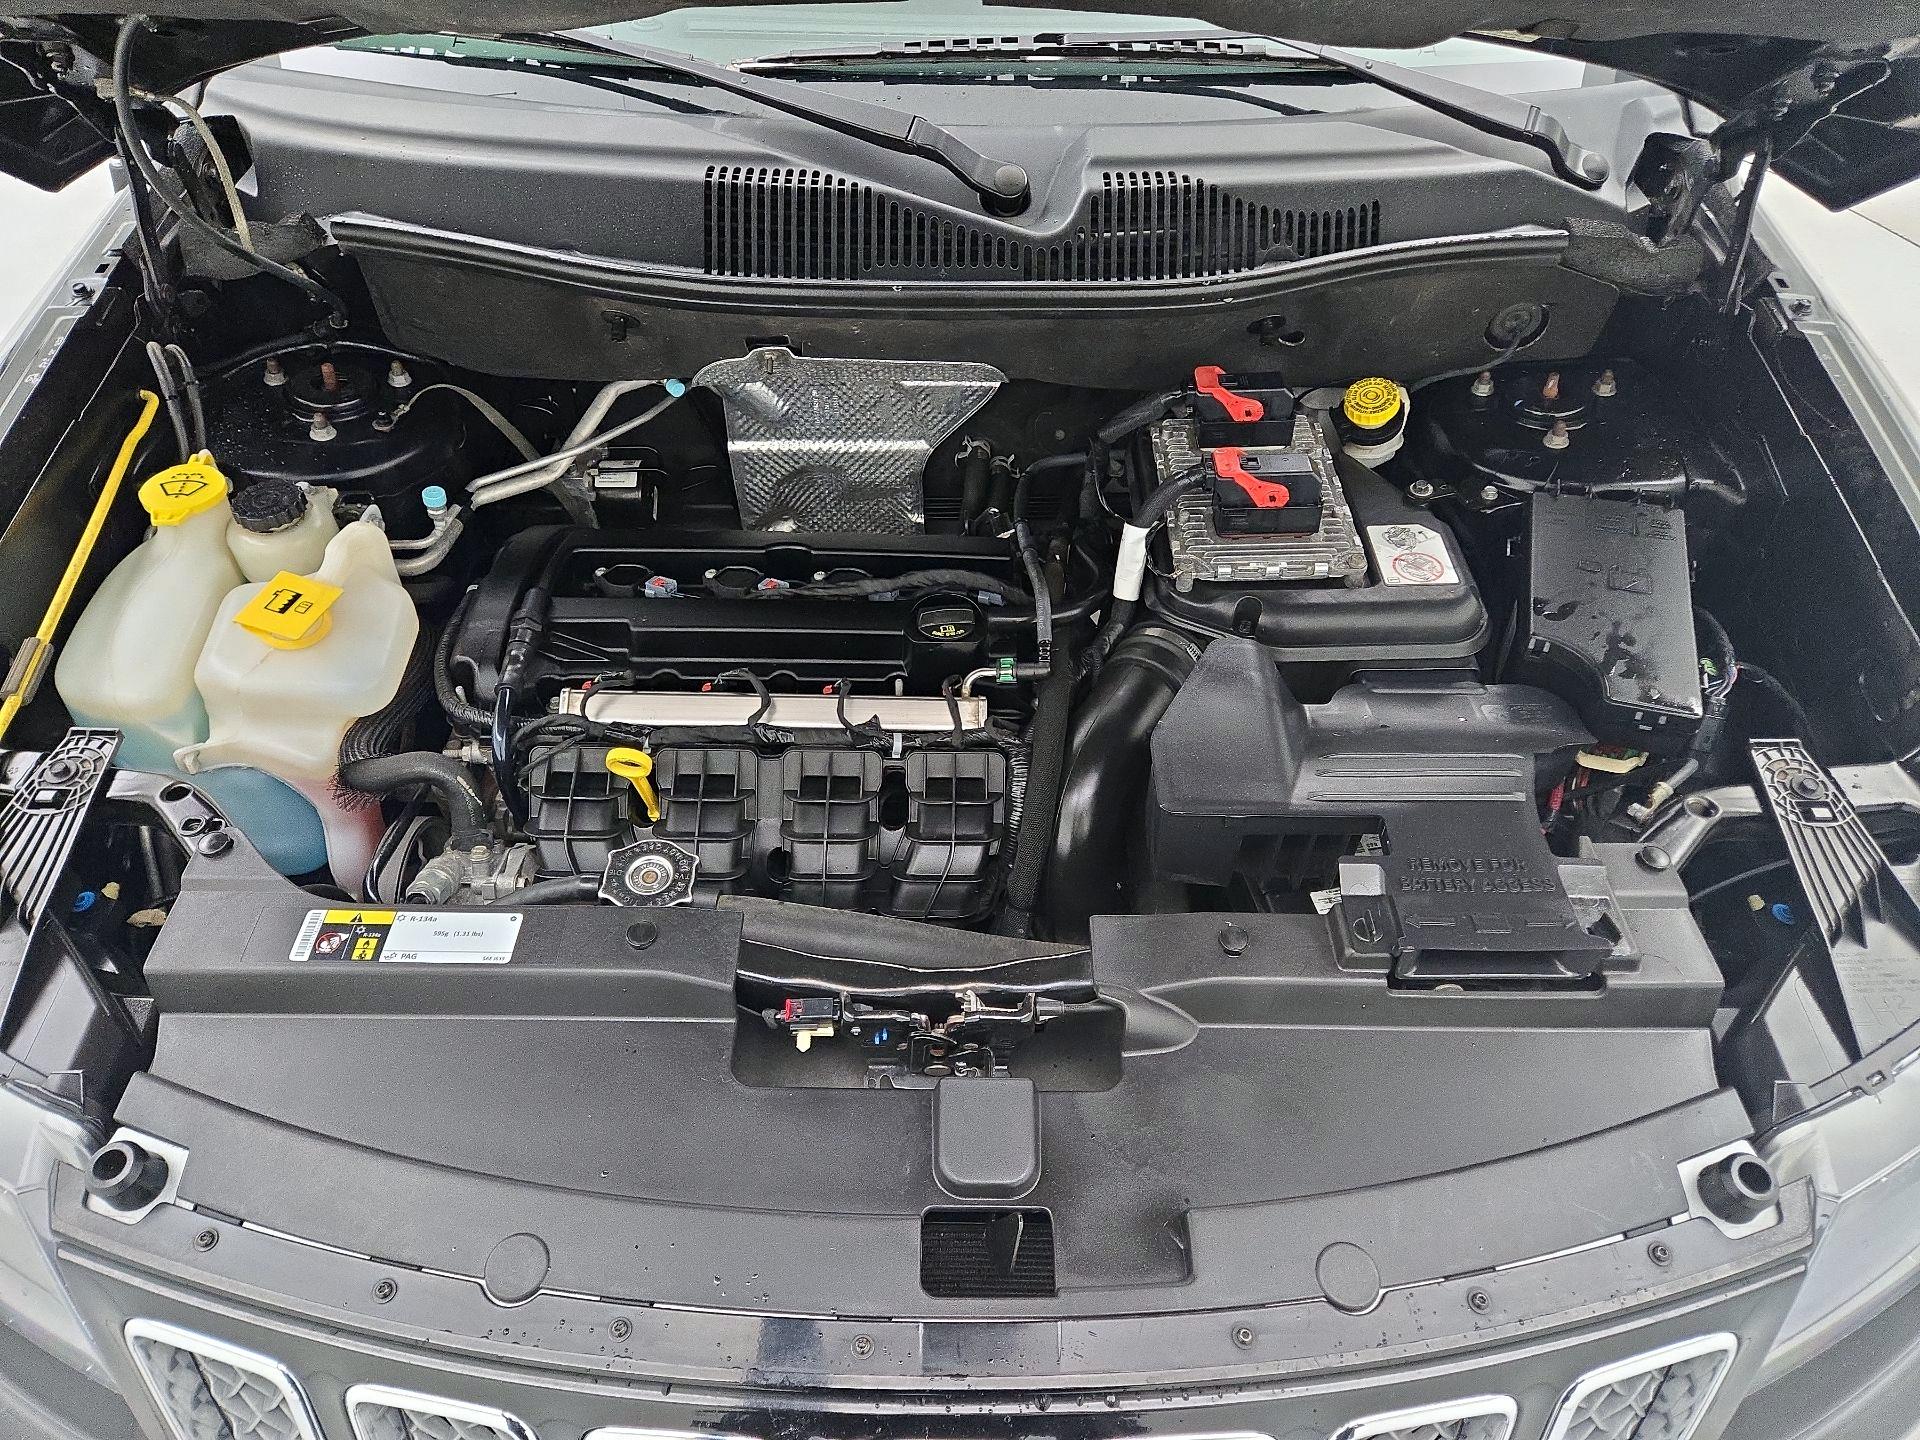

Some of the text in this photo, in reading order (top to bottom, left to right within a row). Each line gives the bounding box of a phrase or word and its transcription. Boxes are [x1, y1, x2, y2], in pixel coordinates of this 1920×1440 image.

[1407, 857, 1527, 873] REMOVE FOR
[1400, 876, 1557, 894] BATTERY ACCESS
[410, 915, 438, 923] R-134a
[432, 930, 449, 938] 595g
